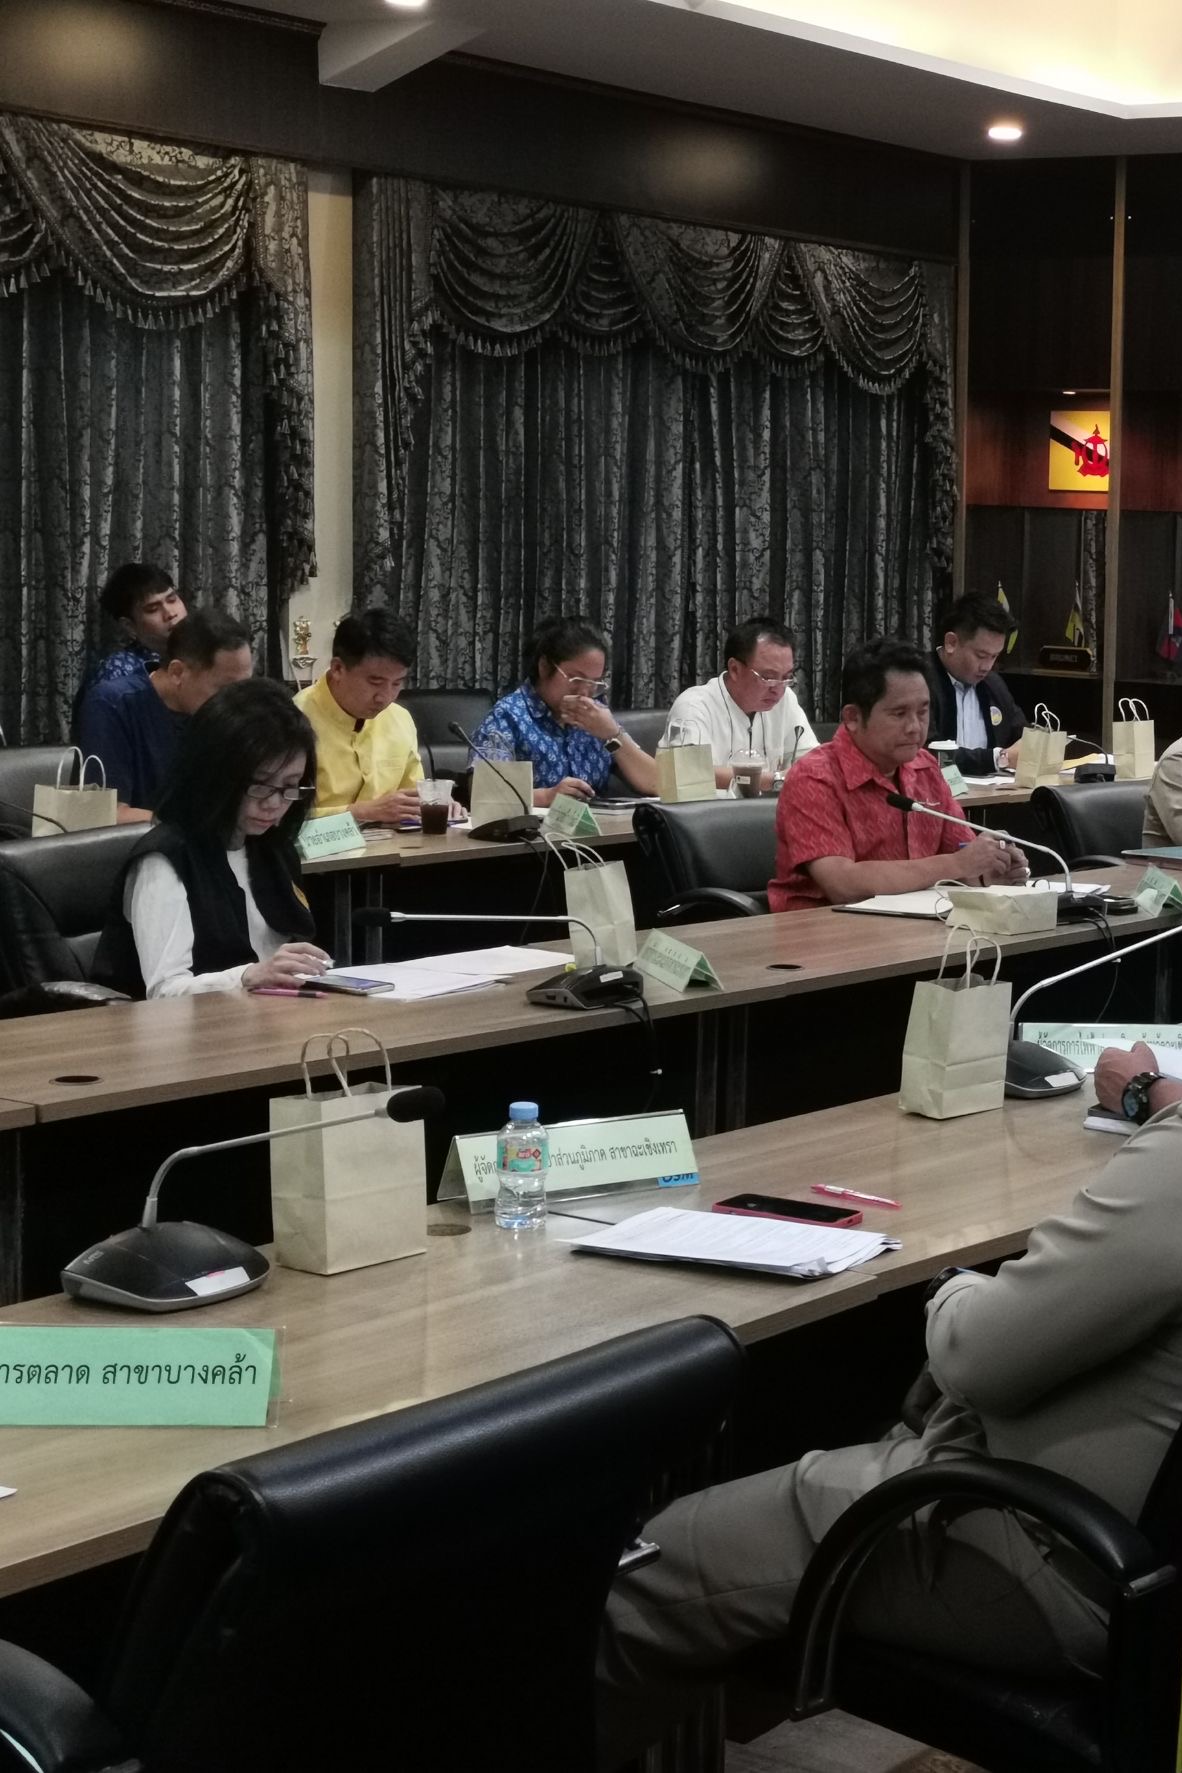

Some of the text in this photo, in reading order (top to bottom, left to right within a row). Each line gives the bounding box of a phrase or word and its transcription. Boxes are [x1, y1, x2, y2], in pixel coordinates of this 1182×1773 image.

[609, 1136, 678, 1160] สาขาฉะเชิงเทรา
[102, 1353, 257, 1385] สาขาบางคล้า
